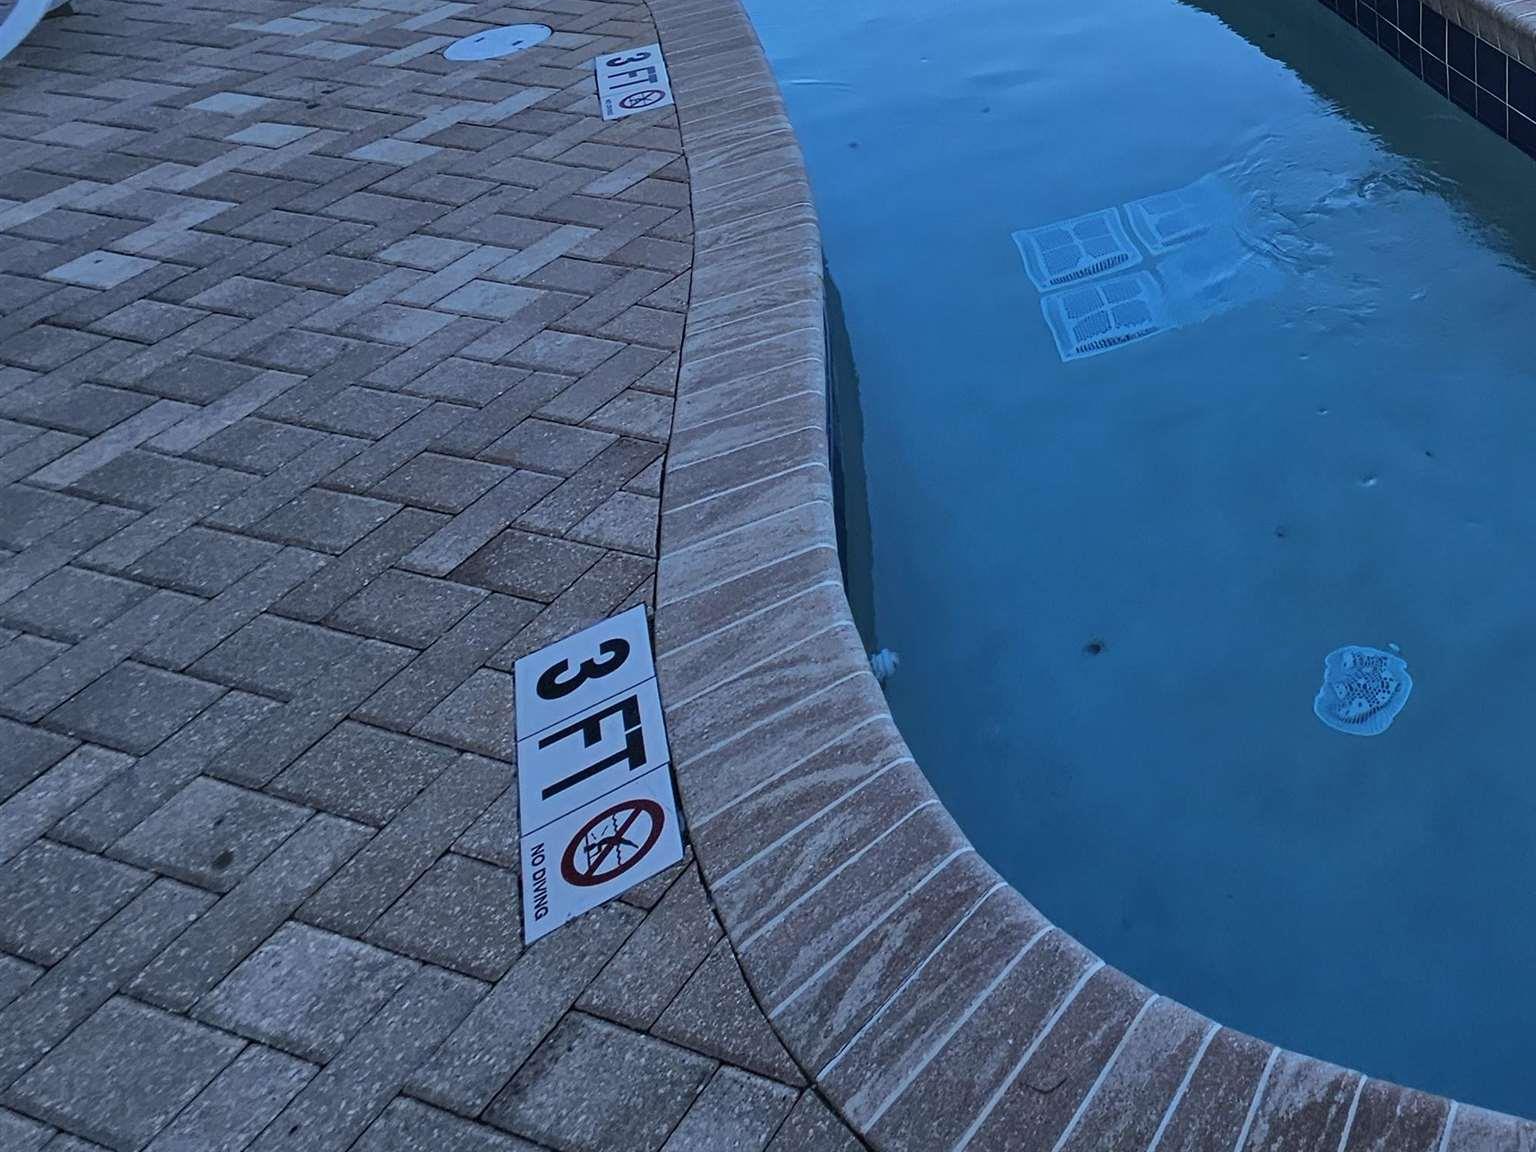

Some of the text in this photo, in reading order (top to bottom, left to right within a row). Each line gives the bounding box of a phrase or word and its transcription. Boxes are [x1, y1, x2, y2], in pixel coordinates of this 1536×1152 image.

[606, 52, 658, 90] 3 FT
[536, 638, 647, 801] 3 FT
[531, 842, 549, 922] NO DIVING
